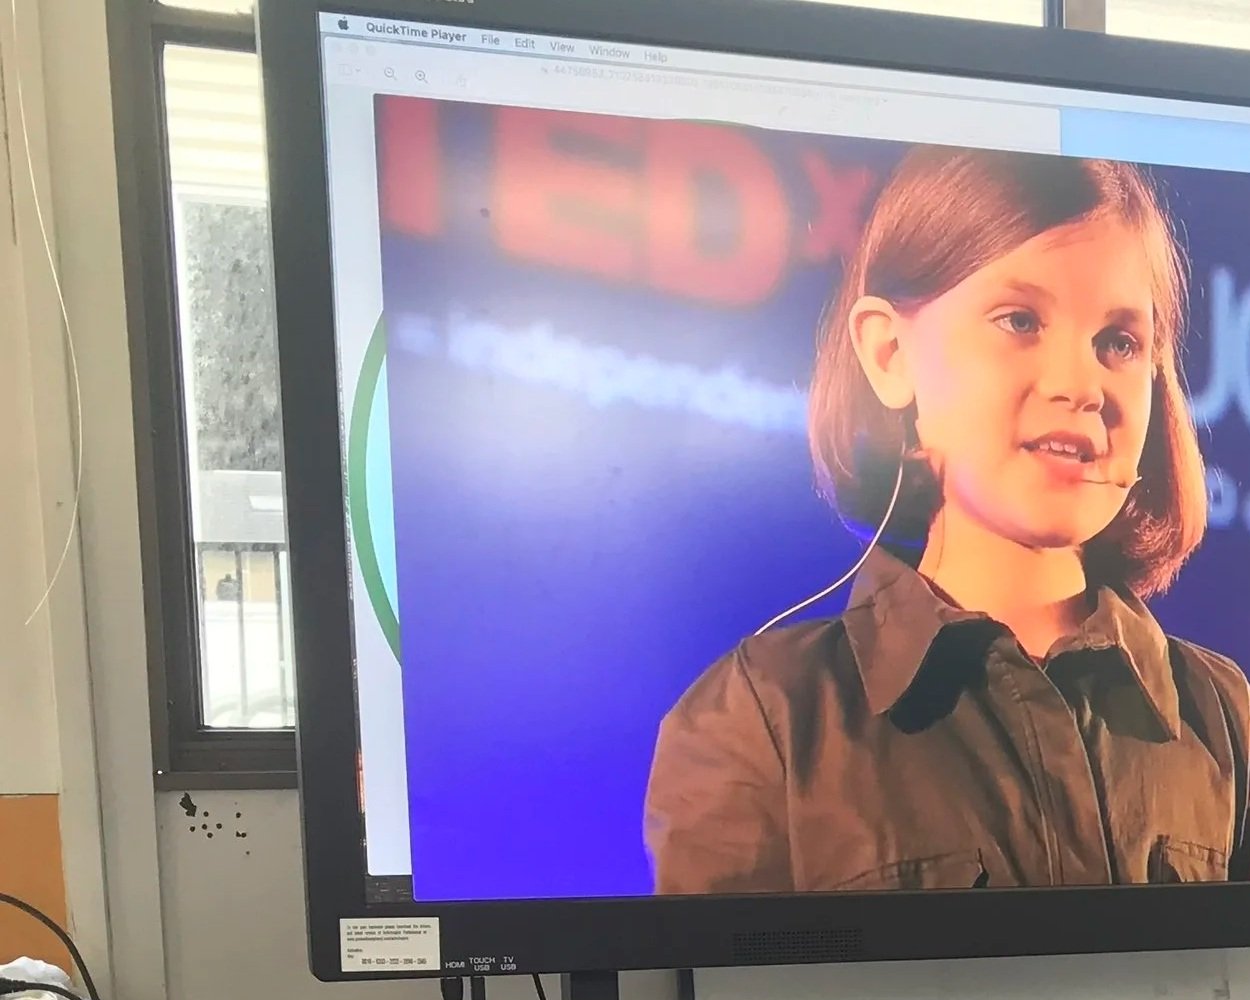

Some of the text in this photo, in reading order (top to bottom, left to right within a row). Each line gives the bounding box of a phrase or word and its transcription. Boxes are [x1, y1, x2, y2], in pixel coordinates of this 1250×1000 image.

[366, 22, 668, 63] QuickTime Player File Edit View Window Help
[469, 956, 495, 964] TOUCH
[445, 961, 516, 972] HDMI USB USB
